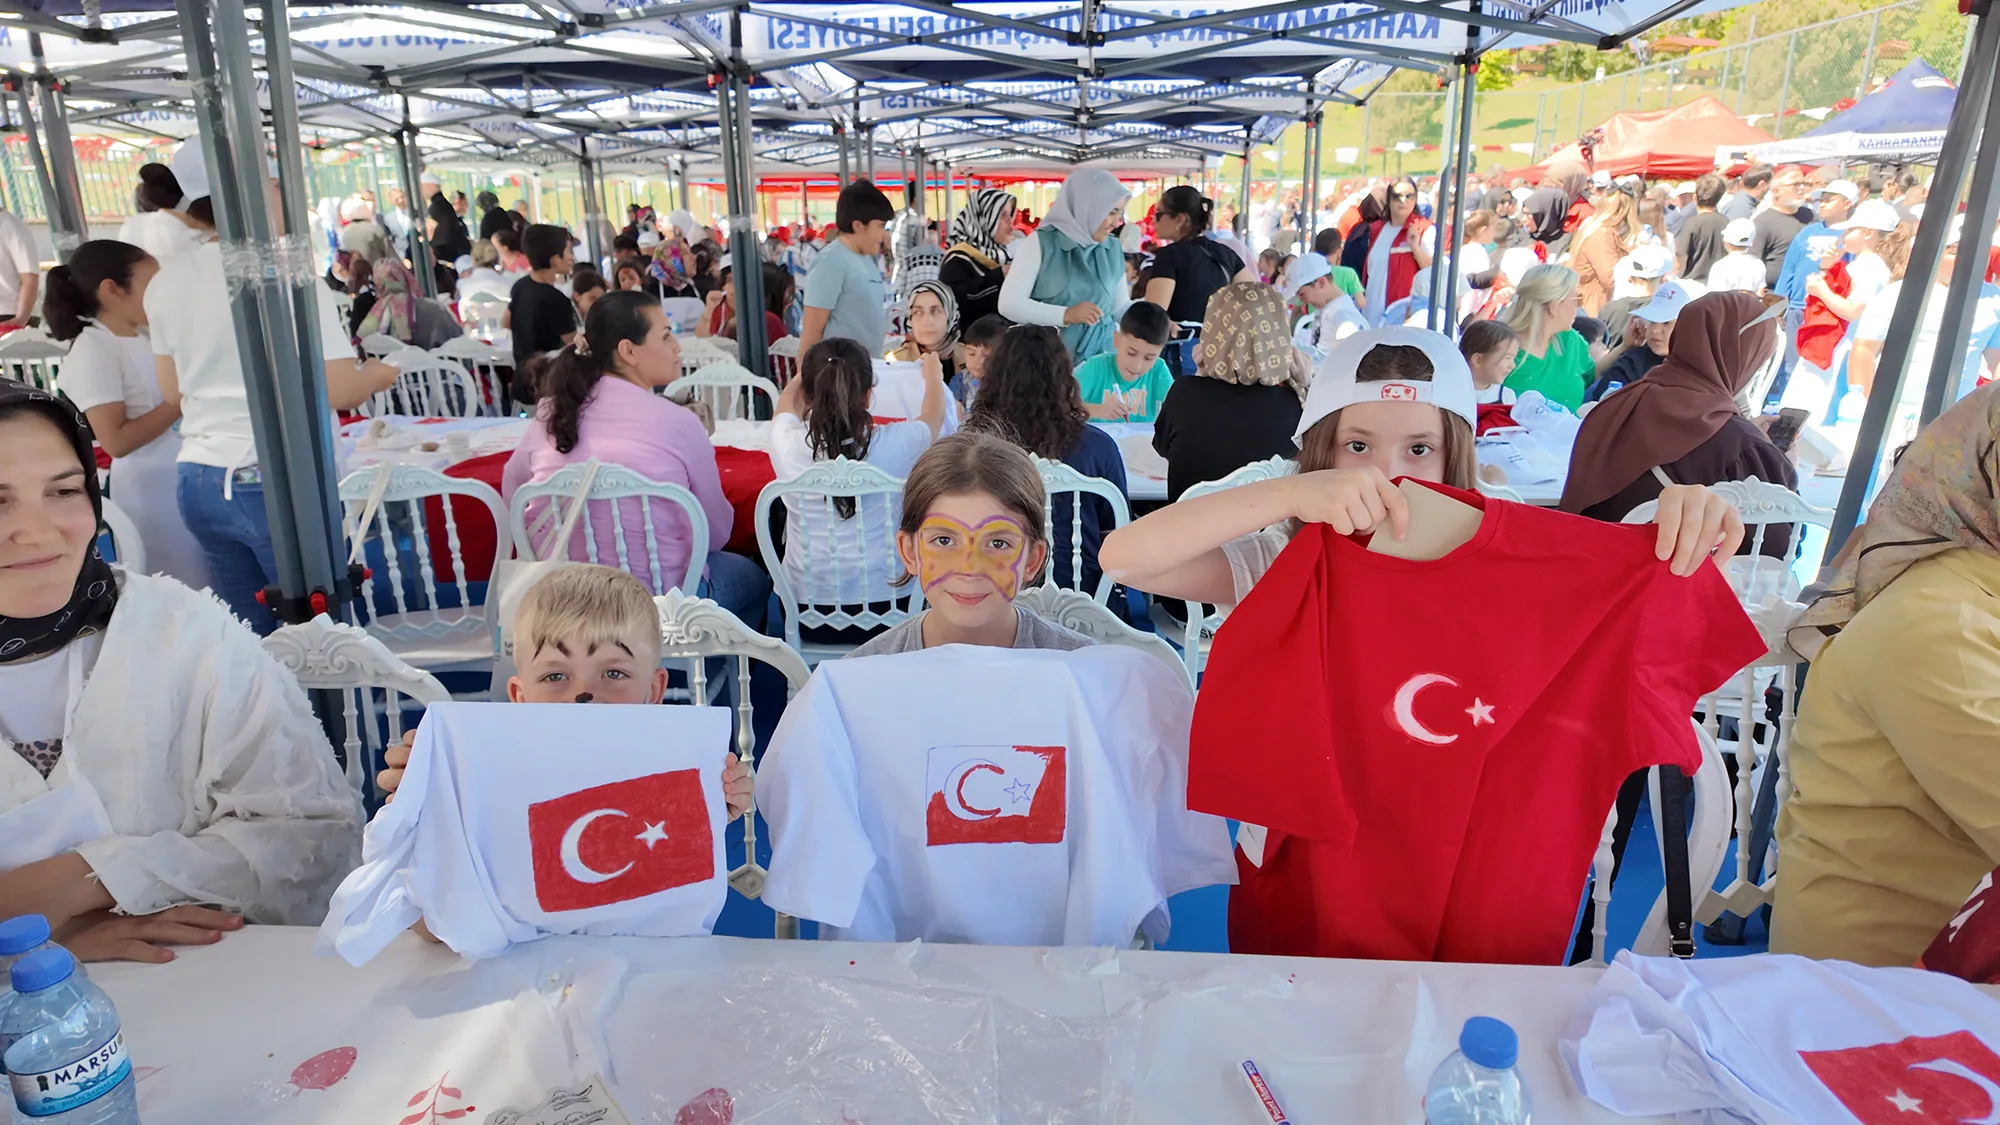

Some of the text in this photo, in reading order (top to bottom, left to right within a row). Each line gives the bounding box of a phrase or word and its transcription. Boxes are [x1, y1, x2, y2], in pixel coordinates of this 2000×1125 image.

[1858, 136, 1945, 149] KAHRAMANMA
[54, 1041, 118, 1085] MARSU
[1250, 1073, 1283, 1121] Paint Marker
